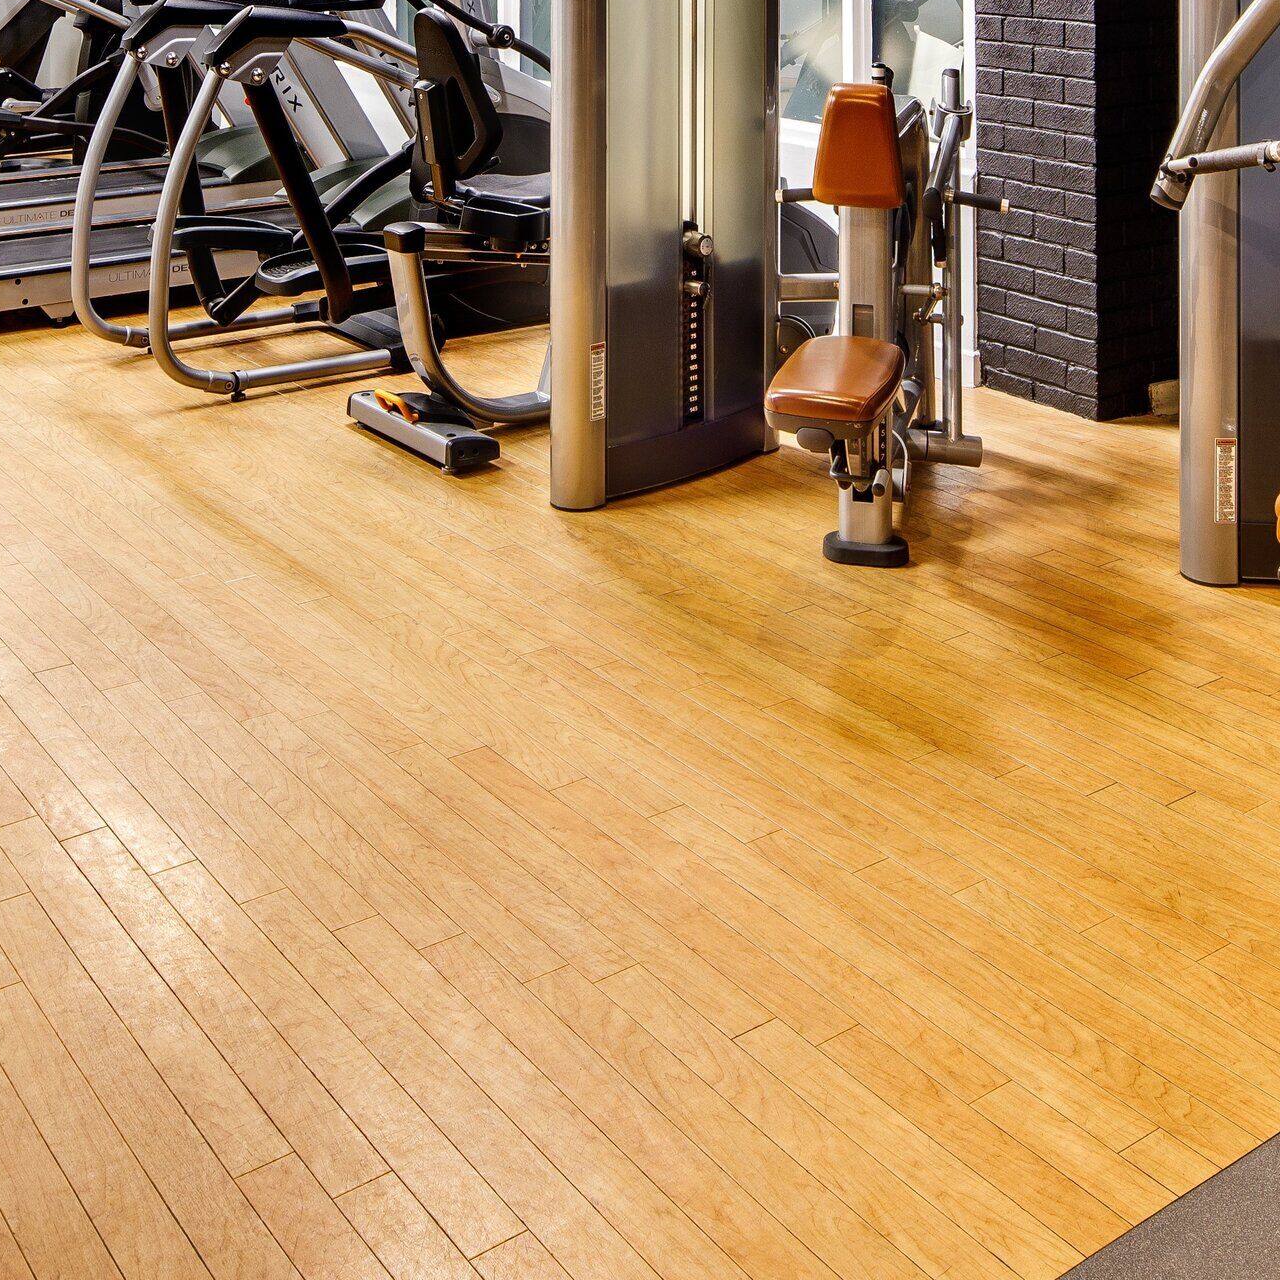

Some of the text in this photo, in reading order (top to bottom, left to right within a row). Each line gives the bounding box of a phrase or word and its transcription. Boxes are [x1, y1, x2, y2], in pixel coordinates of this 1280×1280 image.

[271, 66, 303, 113] RIX
[3, 210, 74, 225] ULTIMATE DE
[108, 264, 188, 283] ULTIMA DE
